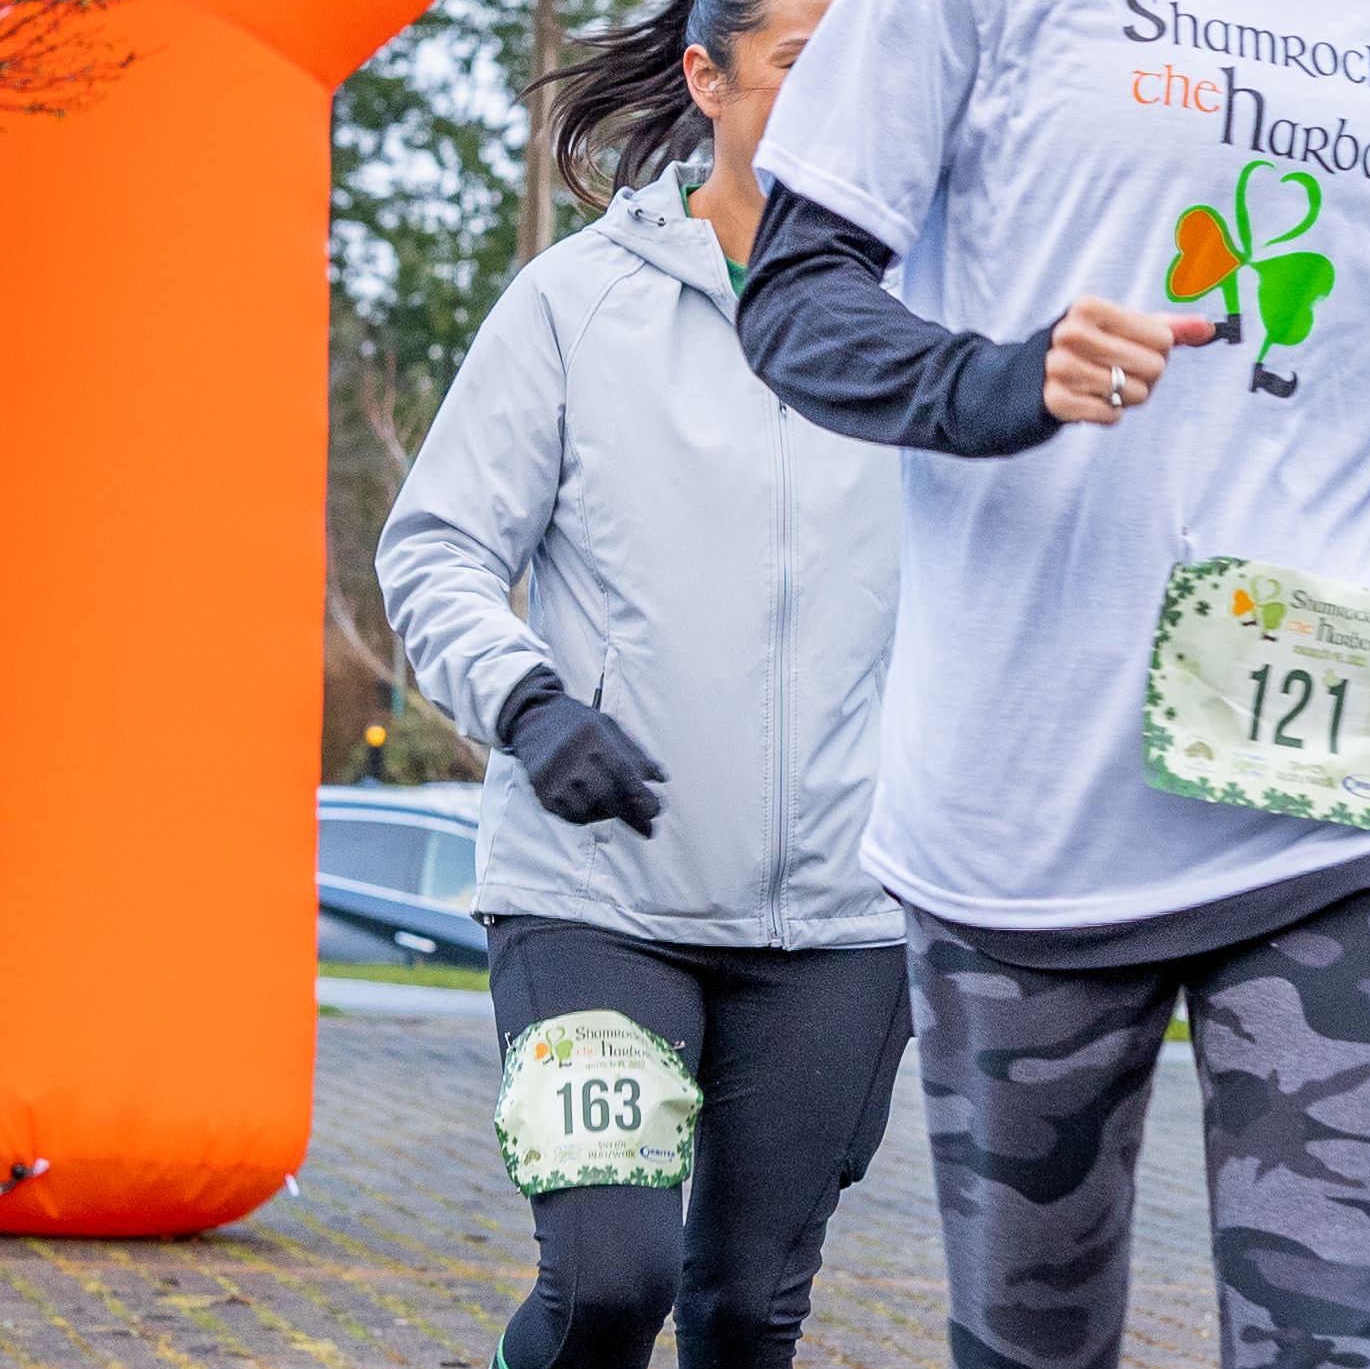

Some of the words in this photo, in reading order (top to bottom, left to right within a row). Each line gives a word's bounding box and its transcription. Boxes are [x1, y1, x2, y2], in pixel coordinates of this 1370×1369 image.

[1131, 64, 1222, 113] the
[1248, 664, 1349, 754] 121
[556, 1078, 642, 1136] 163
